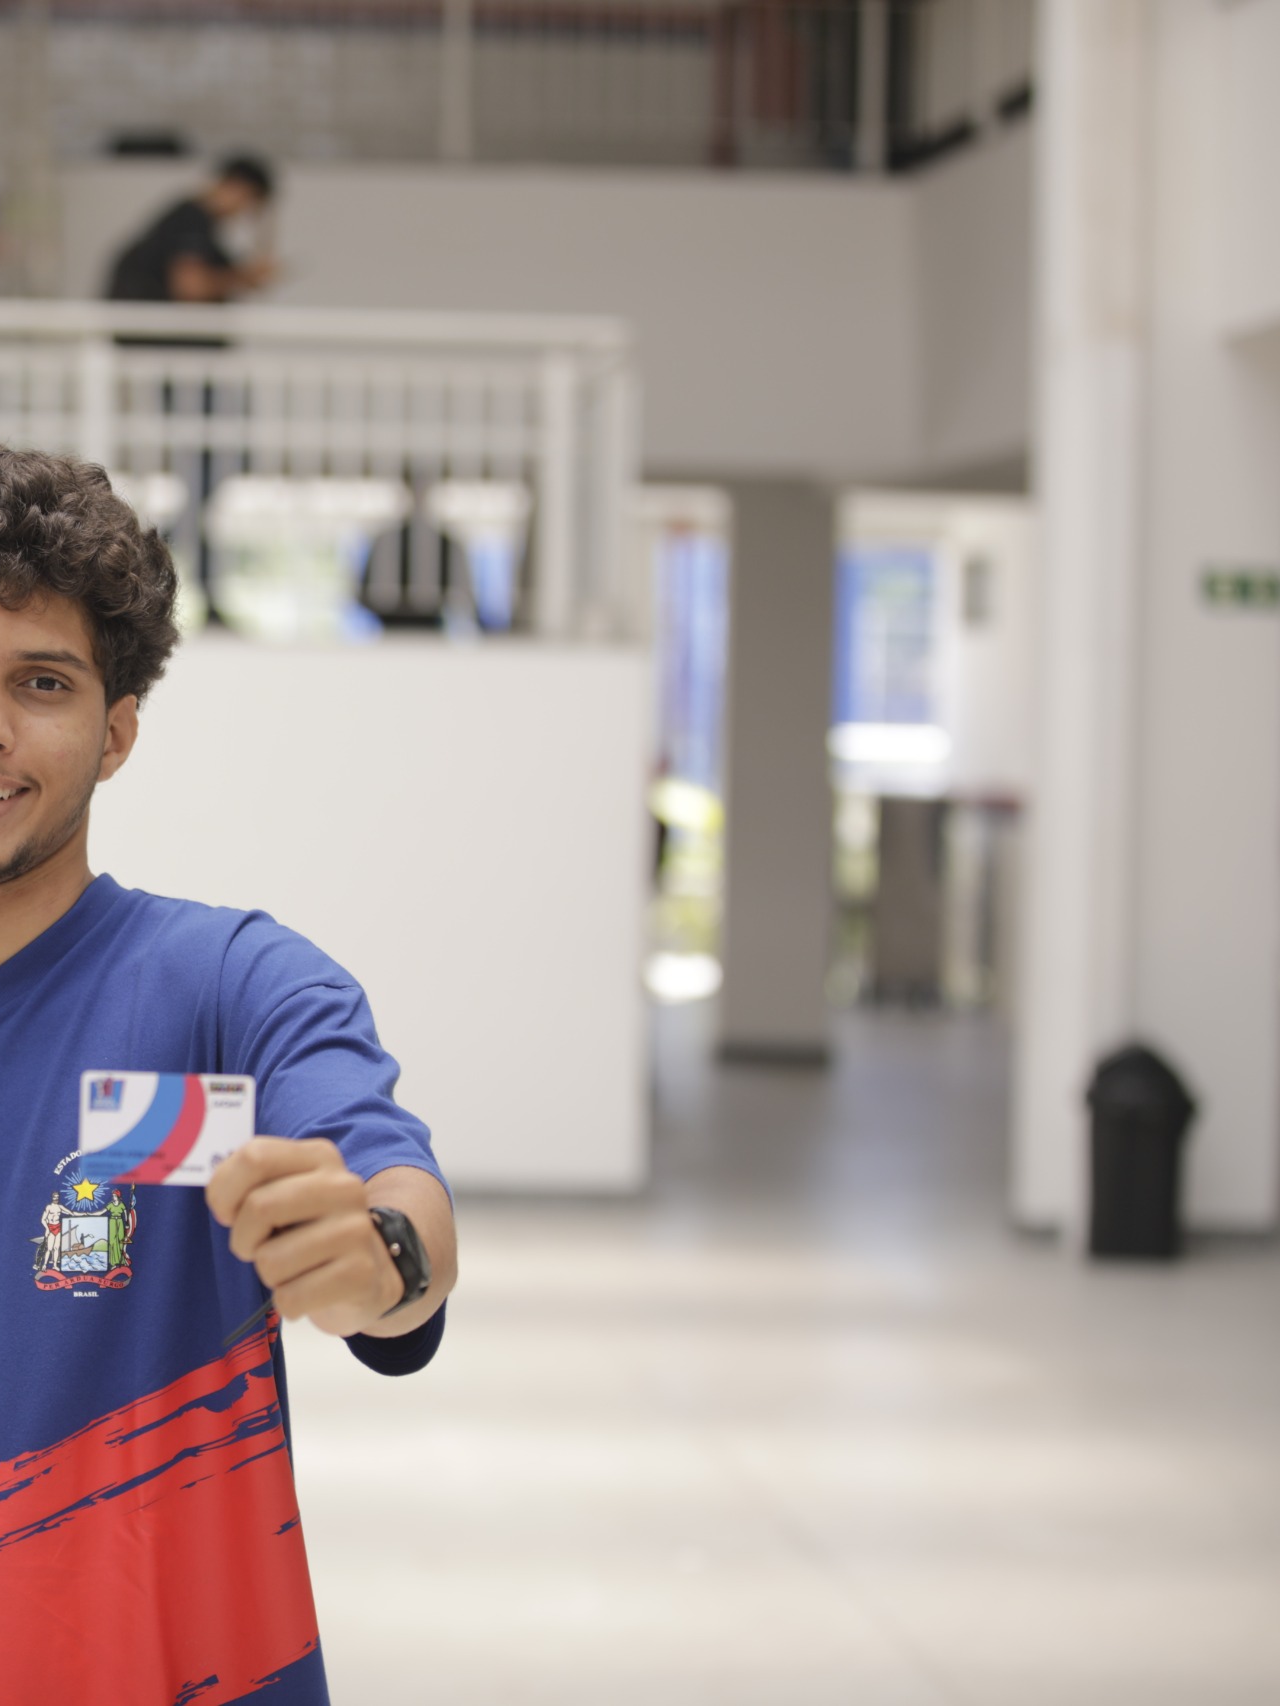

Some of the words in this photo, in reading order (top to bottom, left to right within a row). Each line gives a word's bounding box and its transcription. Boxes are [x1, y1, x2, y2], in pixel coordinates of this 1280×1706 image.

[53, 1149, 82, 1176] ESTADO
[64, 1275, 94, 1286] ARDUA
[98, 1278, 124, 1288] SURGO
